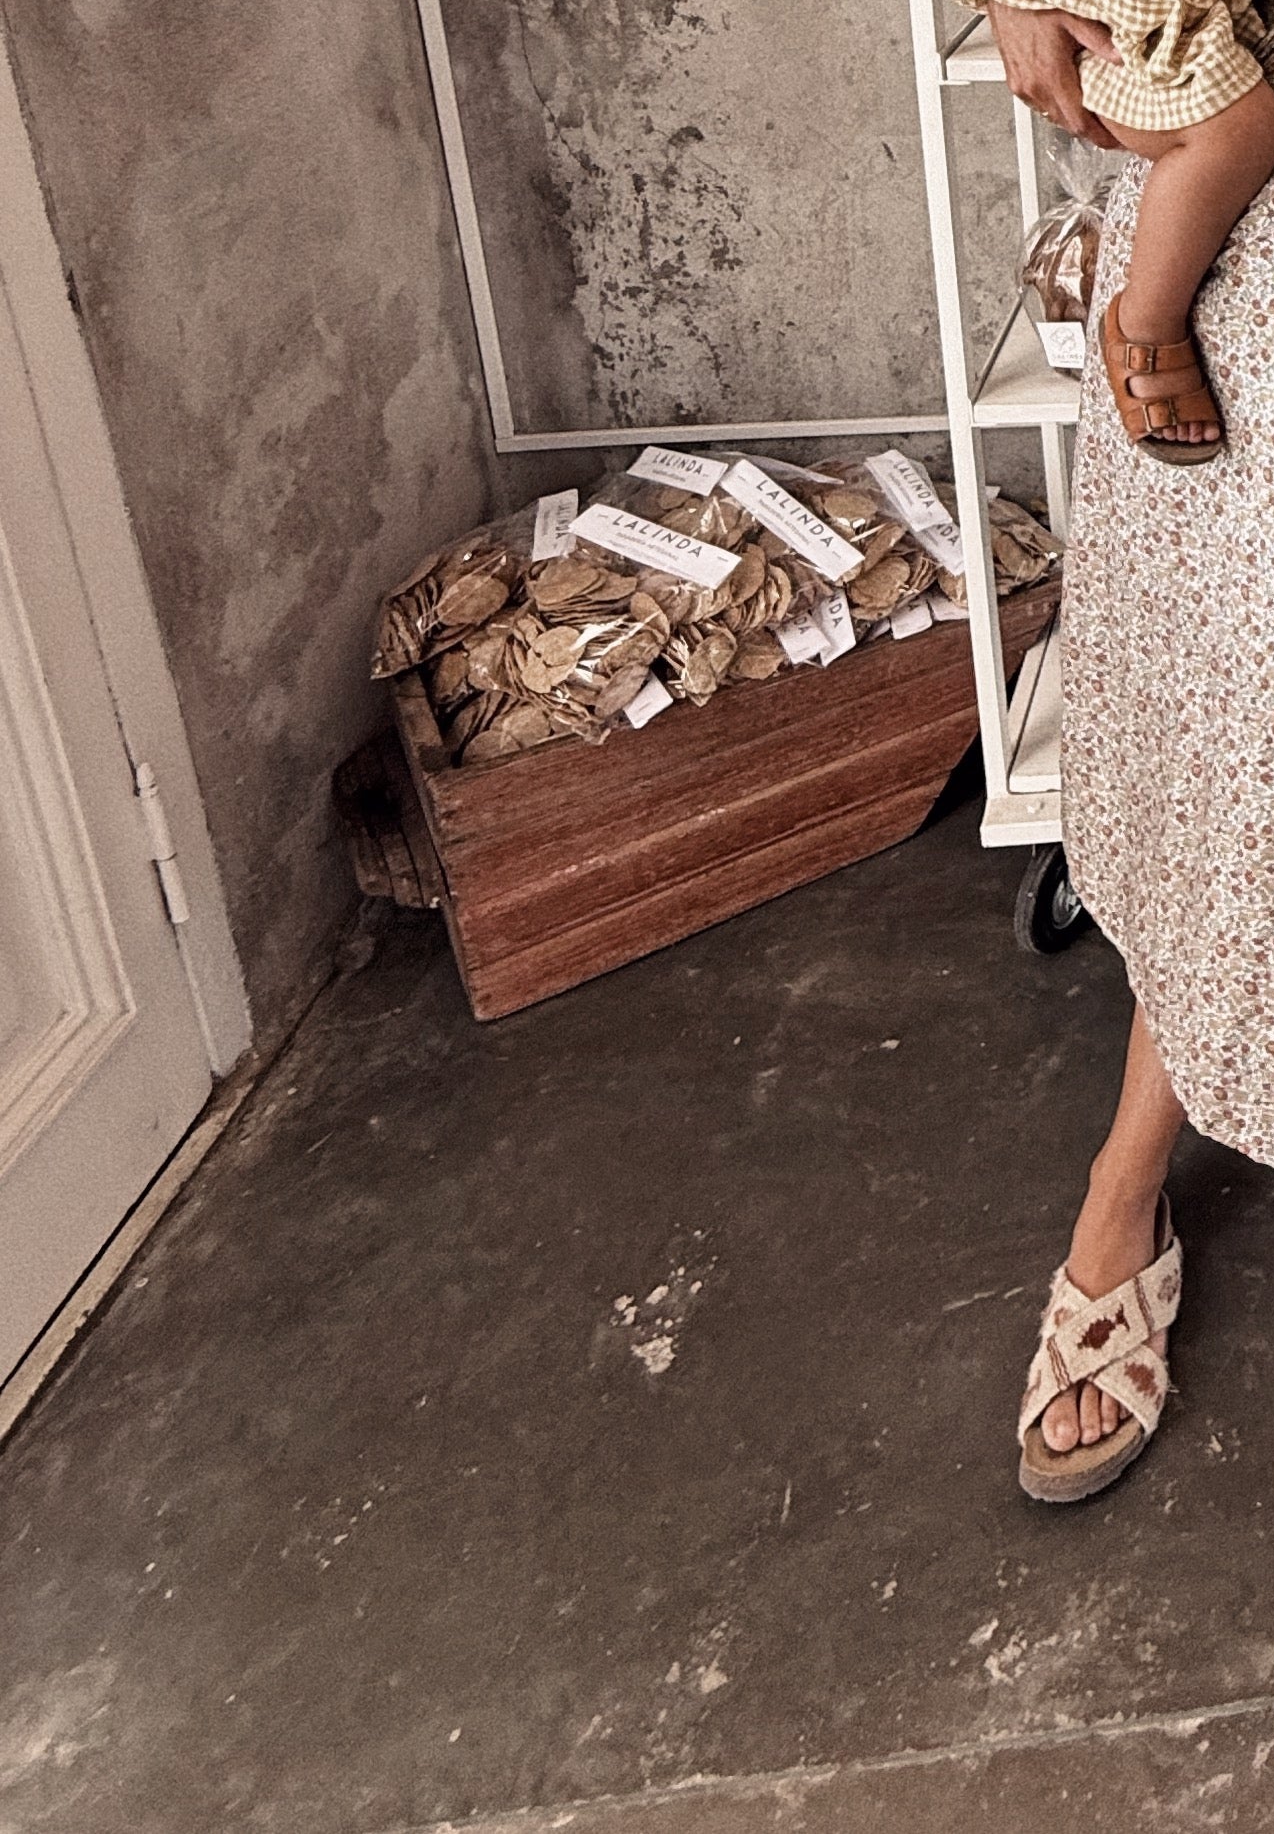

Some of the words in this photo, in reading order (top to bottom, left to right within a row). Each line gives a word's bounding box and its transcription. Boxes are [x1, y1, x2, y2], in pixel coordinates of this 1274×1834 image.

[652, 451, 704, 475] LALINDA
[893, 461, 935, 508] LALINDA
[756, 479, 834, 548] LALINDA
[612, 515, 704, 558] LALINDA
